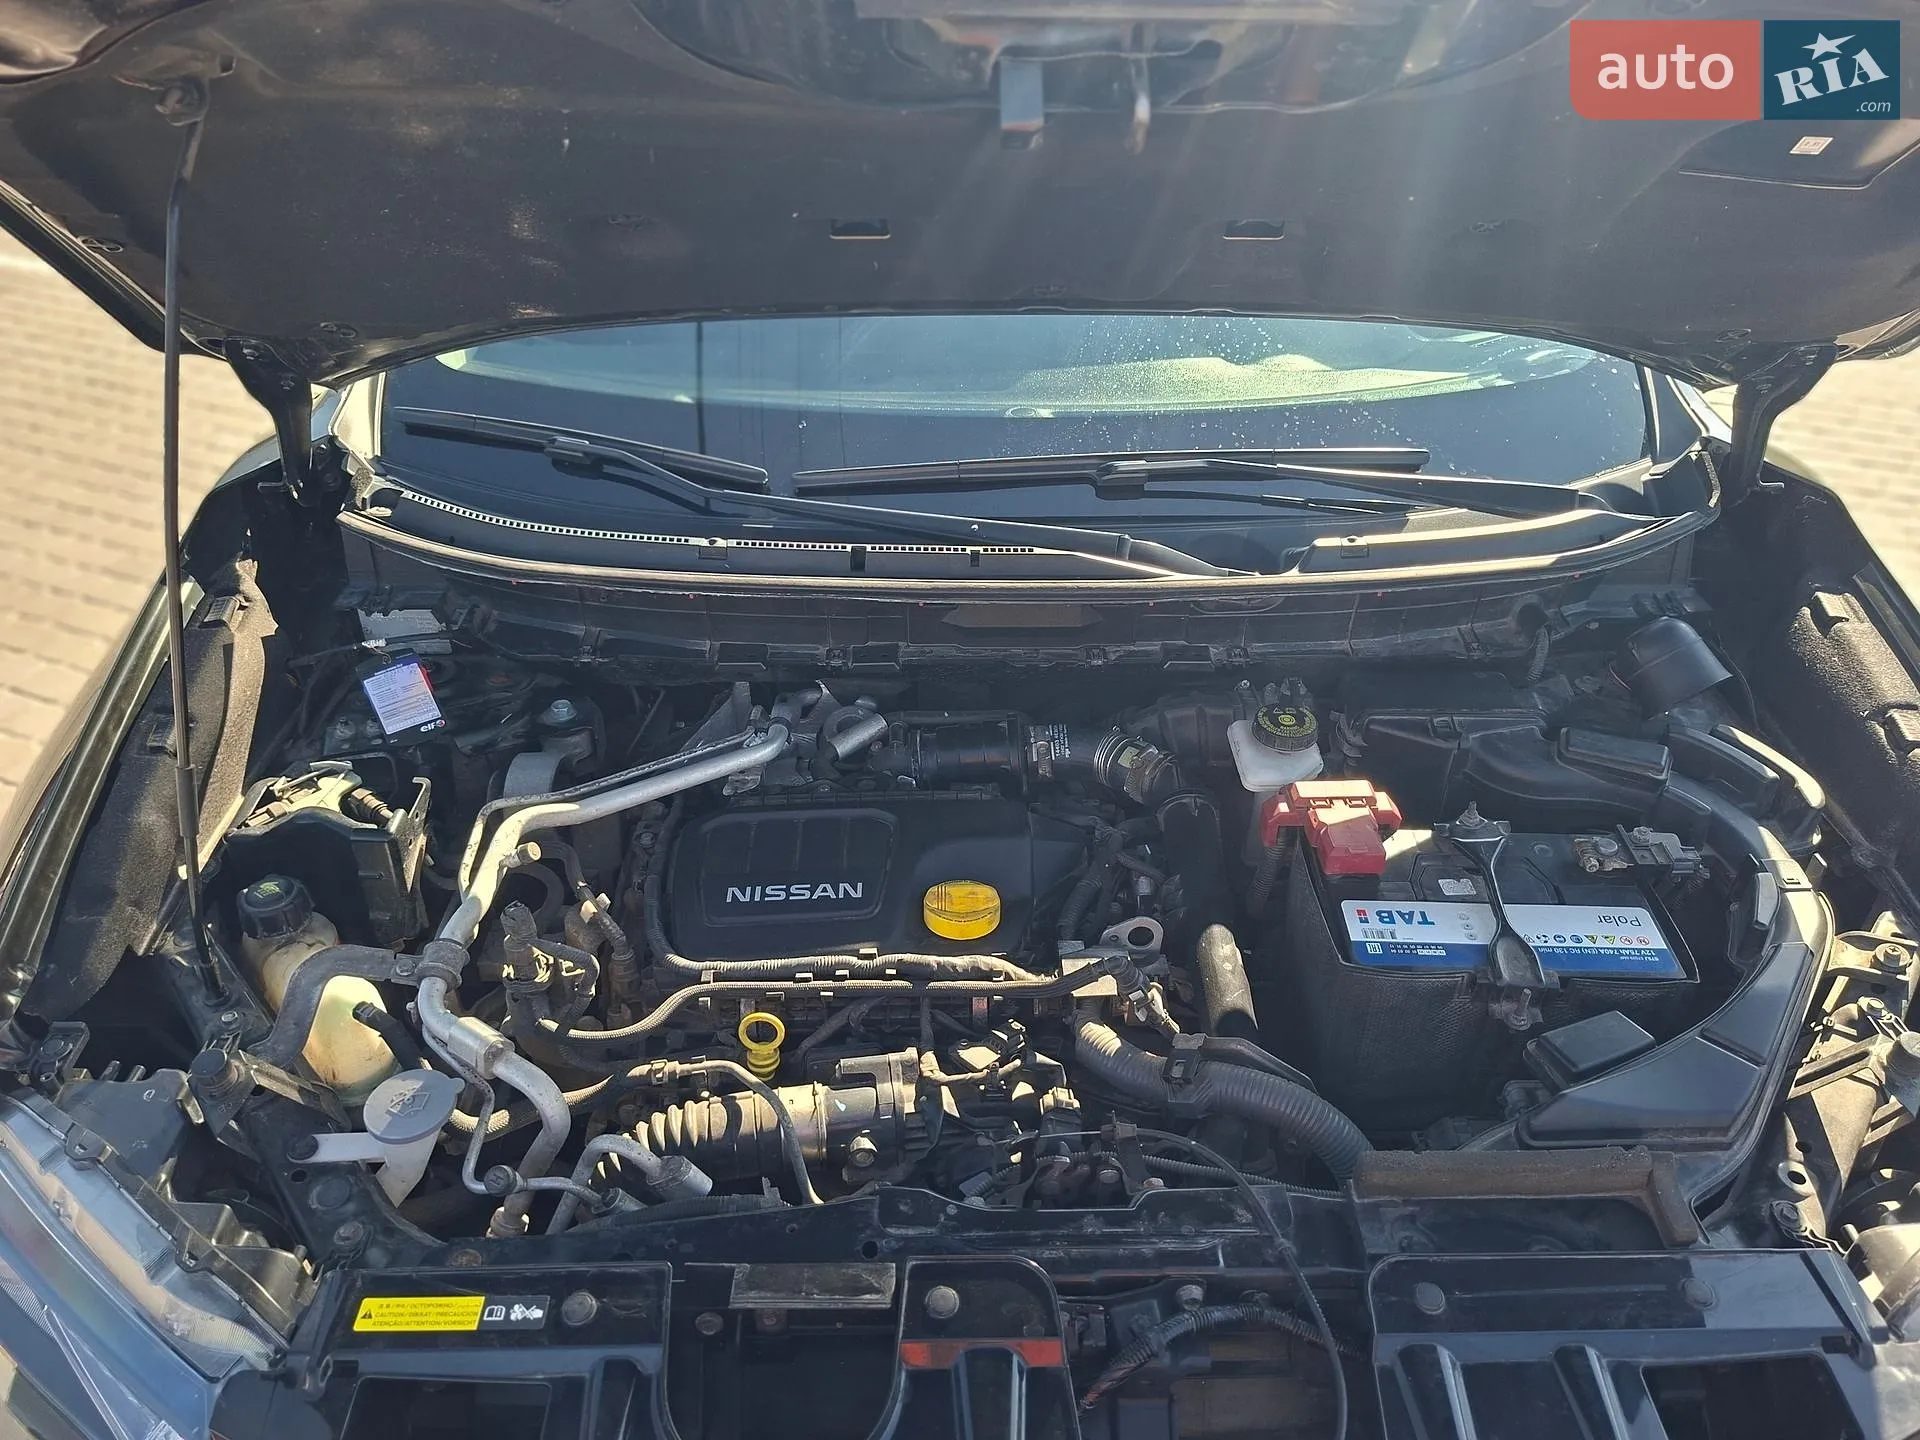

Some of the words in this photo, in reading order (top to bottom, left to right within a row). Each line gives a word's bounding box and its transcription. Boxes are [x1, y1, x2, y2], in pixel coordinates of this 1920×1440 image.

[420, 721, 436, 732] elf
[726, 882, 862, 903] NISSAN
[1376, 910, 1436, 926] TAB
[1597, 915, 1642, 927] Polar
[1582, 947, 1598, 955] (EN)
